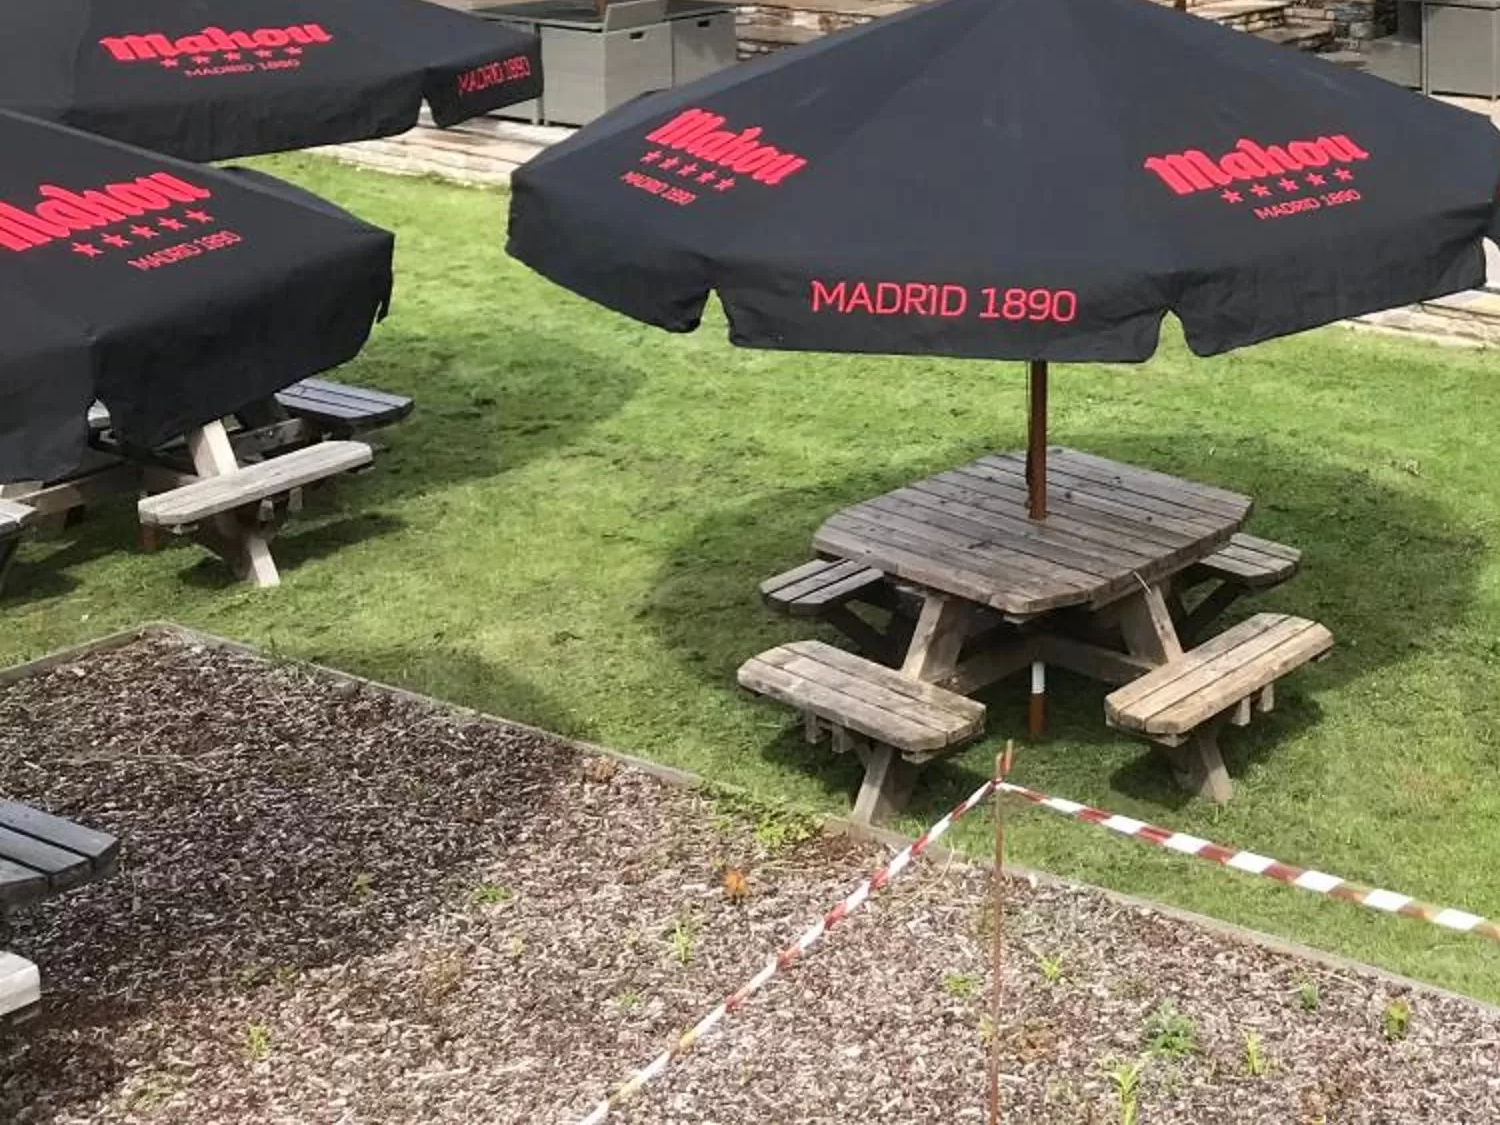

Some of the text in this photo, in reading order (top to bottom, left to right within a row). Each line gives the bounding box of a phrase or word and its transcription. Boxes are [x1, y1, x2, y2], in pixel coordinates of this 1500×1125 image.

[100, 24, 333, 60] Mahou
[645, 108, 807, 185] Mahou
[1144, 134, 1369, 195] Mahou
[1254, 197, 1321, 220] MADRID
[810, 280, 1078, 323] MADRID 1890
